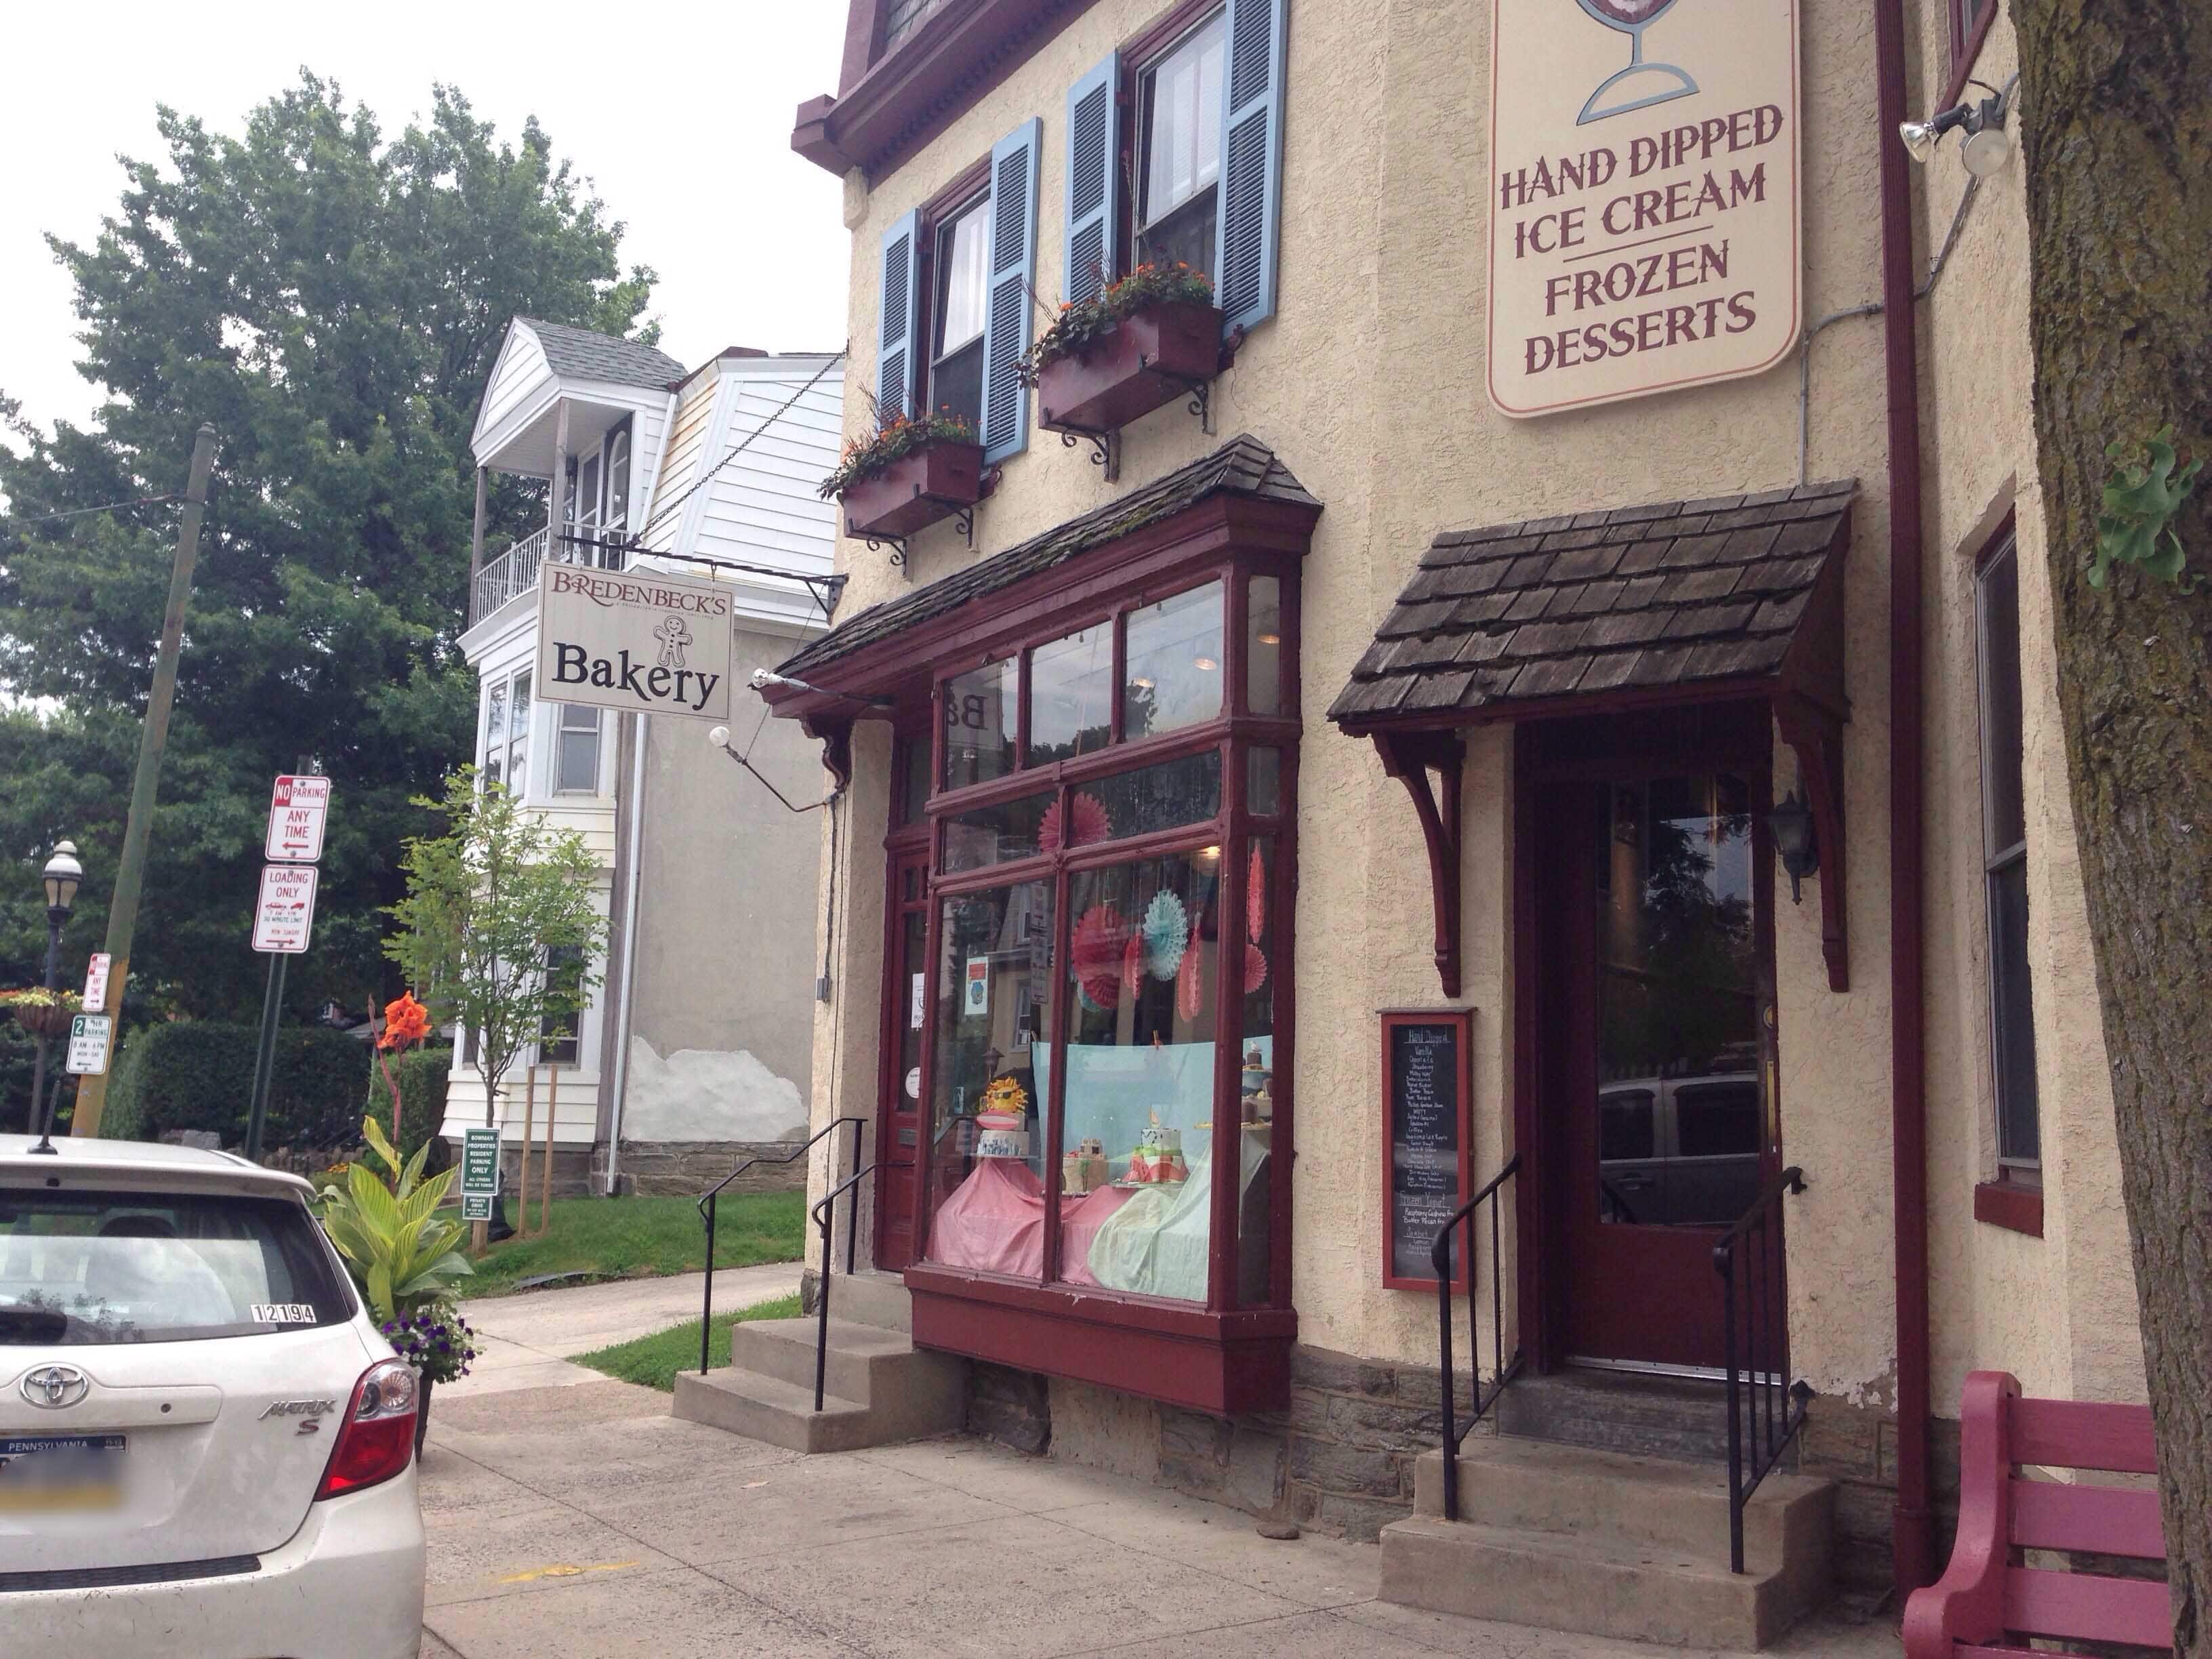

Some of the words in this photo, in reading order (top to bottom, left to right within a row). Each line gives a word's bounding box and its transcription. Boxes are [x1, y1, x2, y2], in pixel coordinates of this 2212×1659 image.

[1500, 147, 1618, 210] HAND
[1628, 103, 1785, 178] DIPPED
[1514, 206, 1586, 259] ICE
[1600, 162, 1766, 235] CREAM
[1545, 239, 1729, 317] FROZEN
[1523, 291, 1757, 375] DESSERTS
[551, 571, 726, 616] BREDENBECK'S
[552, 642, 720, 712] Bakery
[276, 785, 291, 800] NO
[292, 787, 325, 798] PARKING
[287, 810, 310, 823] ANY
[284, 825, 310, 838] TIME
[270, 872, 309, 884] LOADING
[276, 887, 300, 898] ONLY
[75, 1020, 83, 1035] 2
[254, 1305, 314, 1322] 12194
[295, 1418, 320, 1436] S
